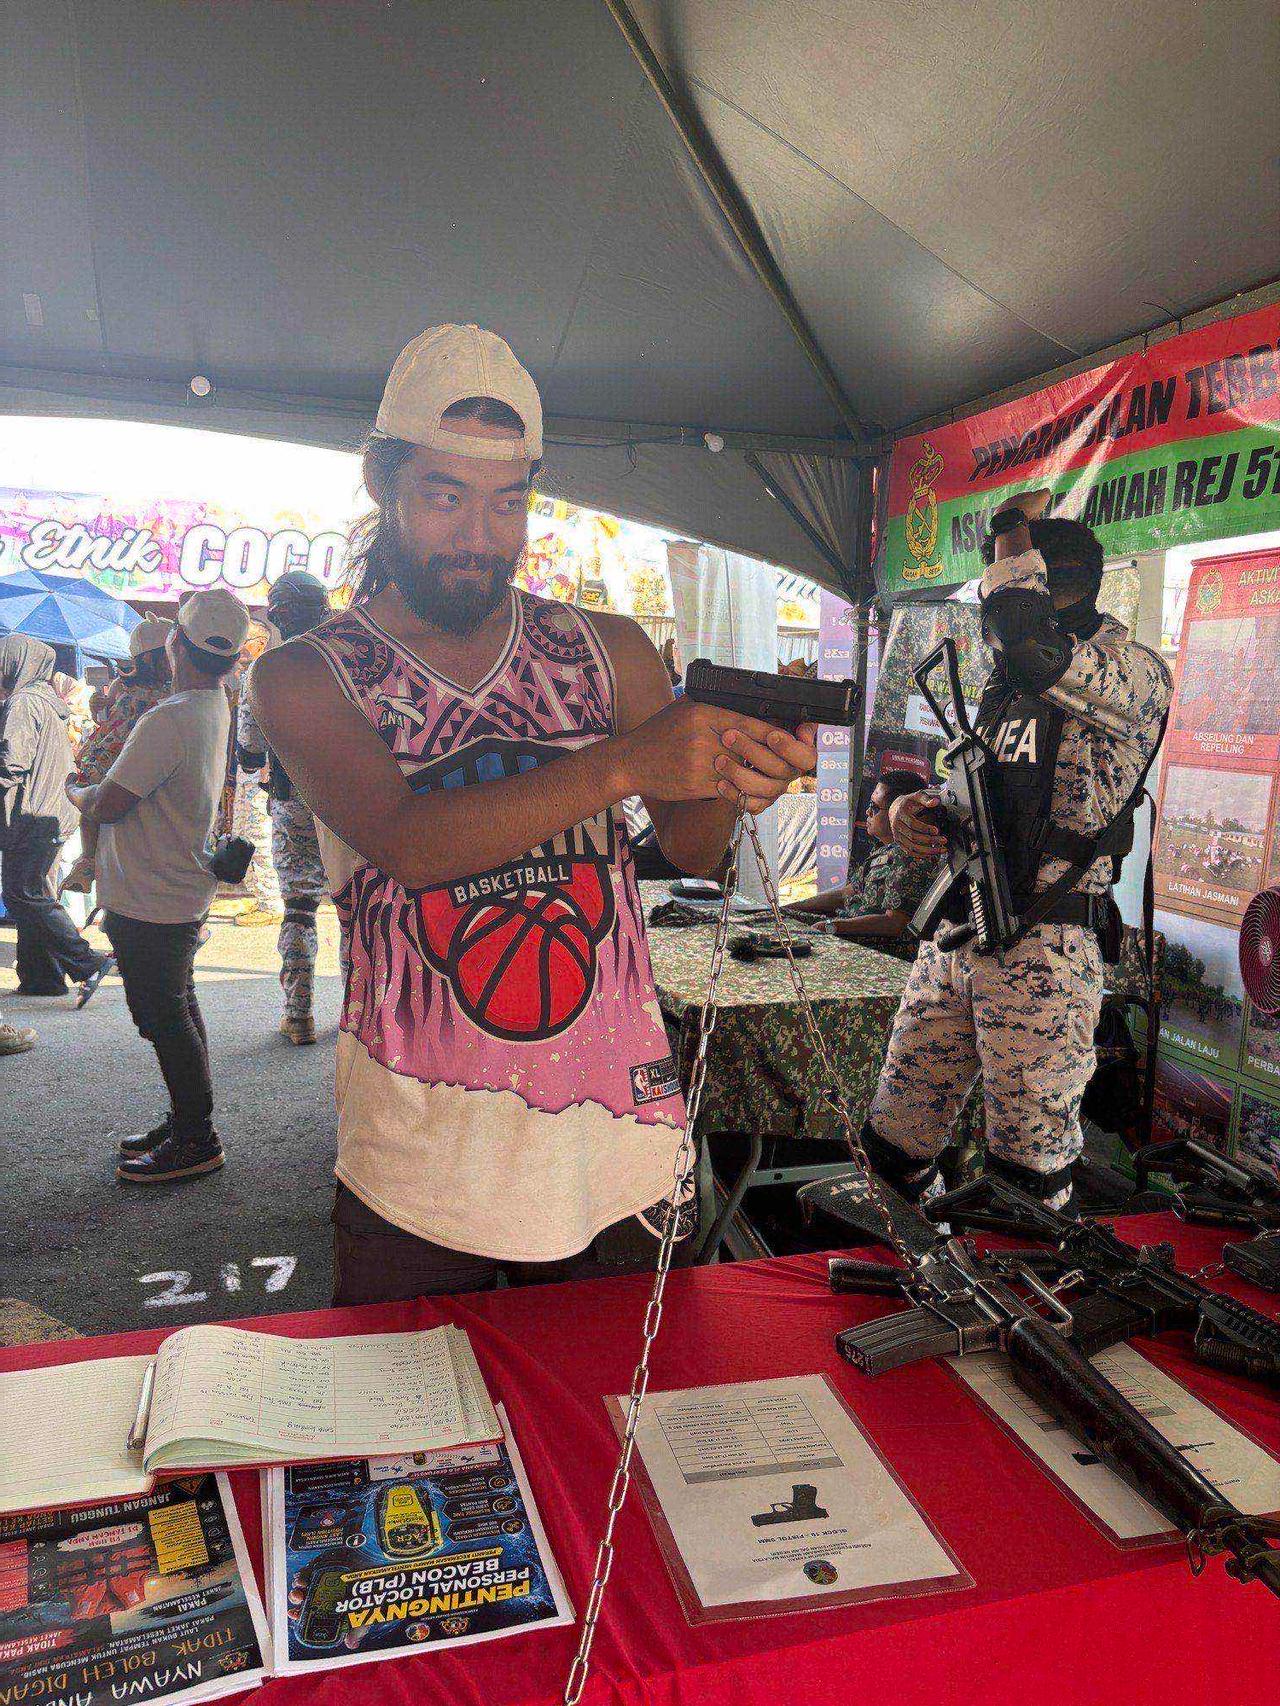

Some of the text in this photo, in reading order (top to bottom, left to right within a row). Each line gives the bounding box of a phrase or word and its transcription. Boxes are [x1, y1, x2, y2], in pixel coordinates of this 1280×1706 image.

[1172, 452, 1240, 512] REJ
[454, 864, 570, 904] BASKETBALL
[1168, 881, 1201, 897] LATIHAN
[123, 1491, 171, 1512] JANGAN
[70, 1504, 121, 1524] TUNGGU
[352, 1557, 500, 1597] BEACON (PLB)
[335, 1567, 530, 1613] PERSONAL LOCATOR
[177, 1598, 207, 1612] PAKAI
[348, 1580, 531, 1629] PENTINGNYA
[167, 1620, 190, 1632] JAKET
[192, 1614, 215, 1626] PAKAI
[151, 1632, 178, 1644] BUKAN
[180, 1626, 199, 1637] LAUT
[26, 1638, 57, 1653] TIDAK
[119, 1639, 150, 1652] TEMPAT
[171, 1627, 234, 1656] TIDAK
[50, 1656, 89, 1671] MENCUBA
[91, 1648, 118, 1661] UNTUK
[82, 1651, 156, 1684] BOLEH
[111, 1660, 202, 1700] NYAWA
